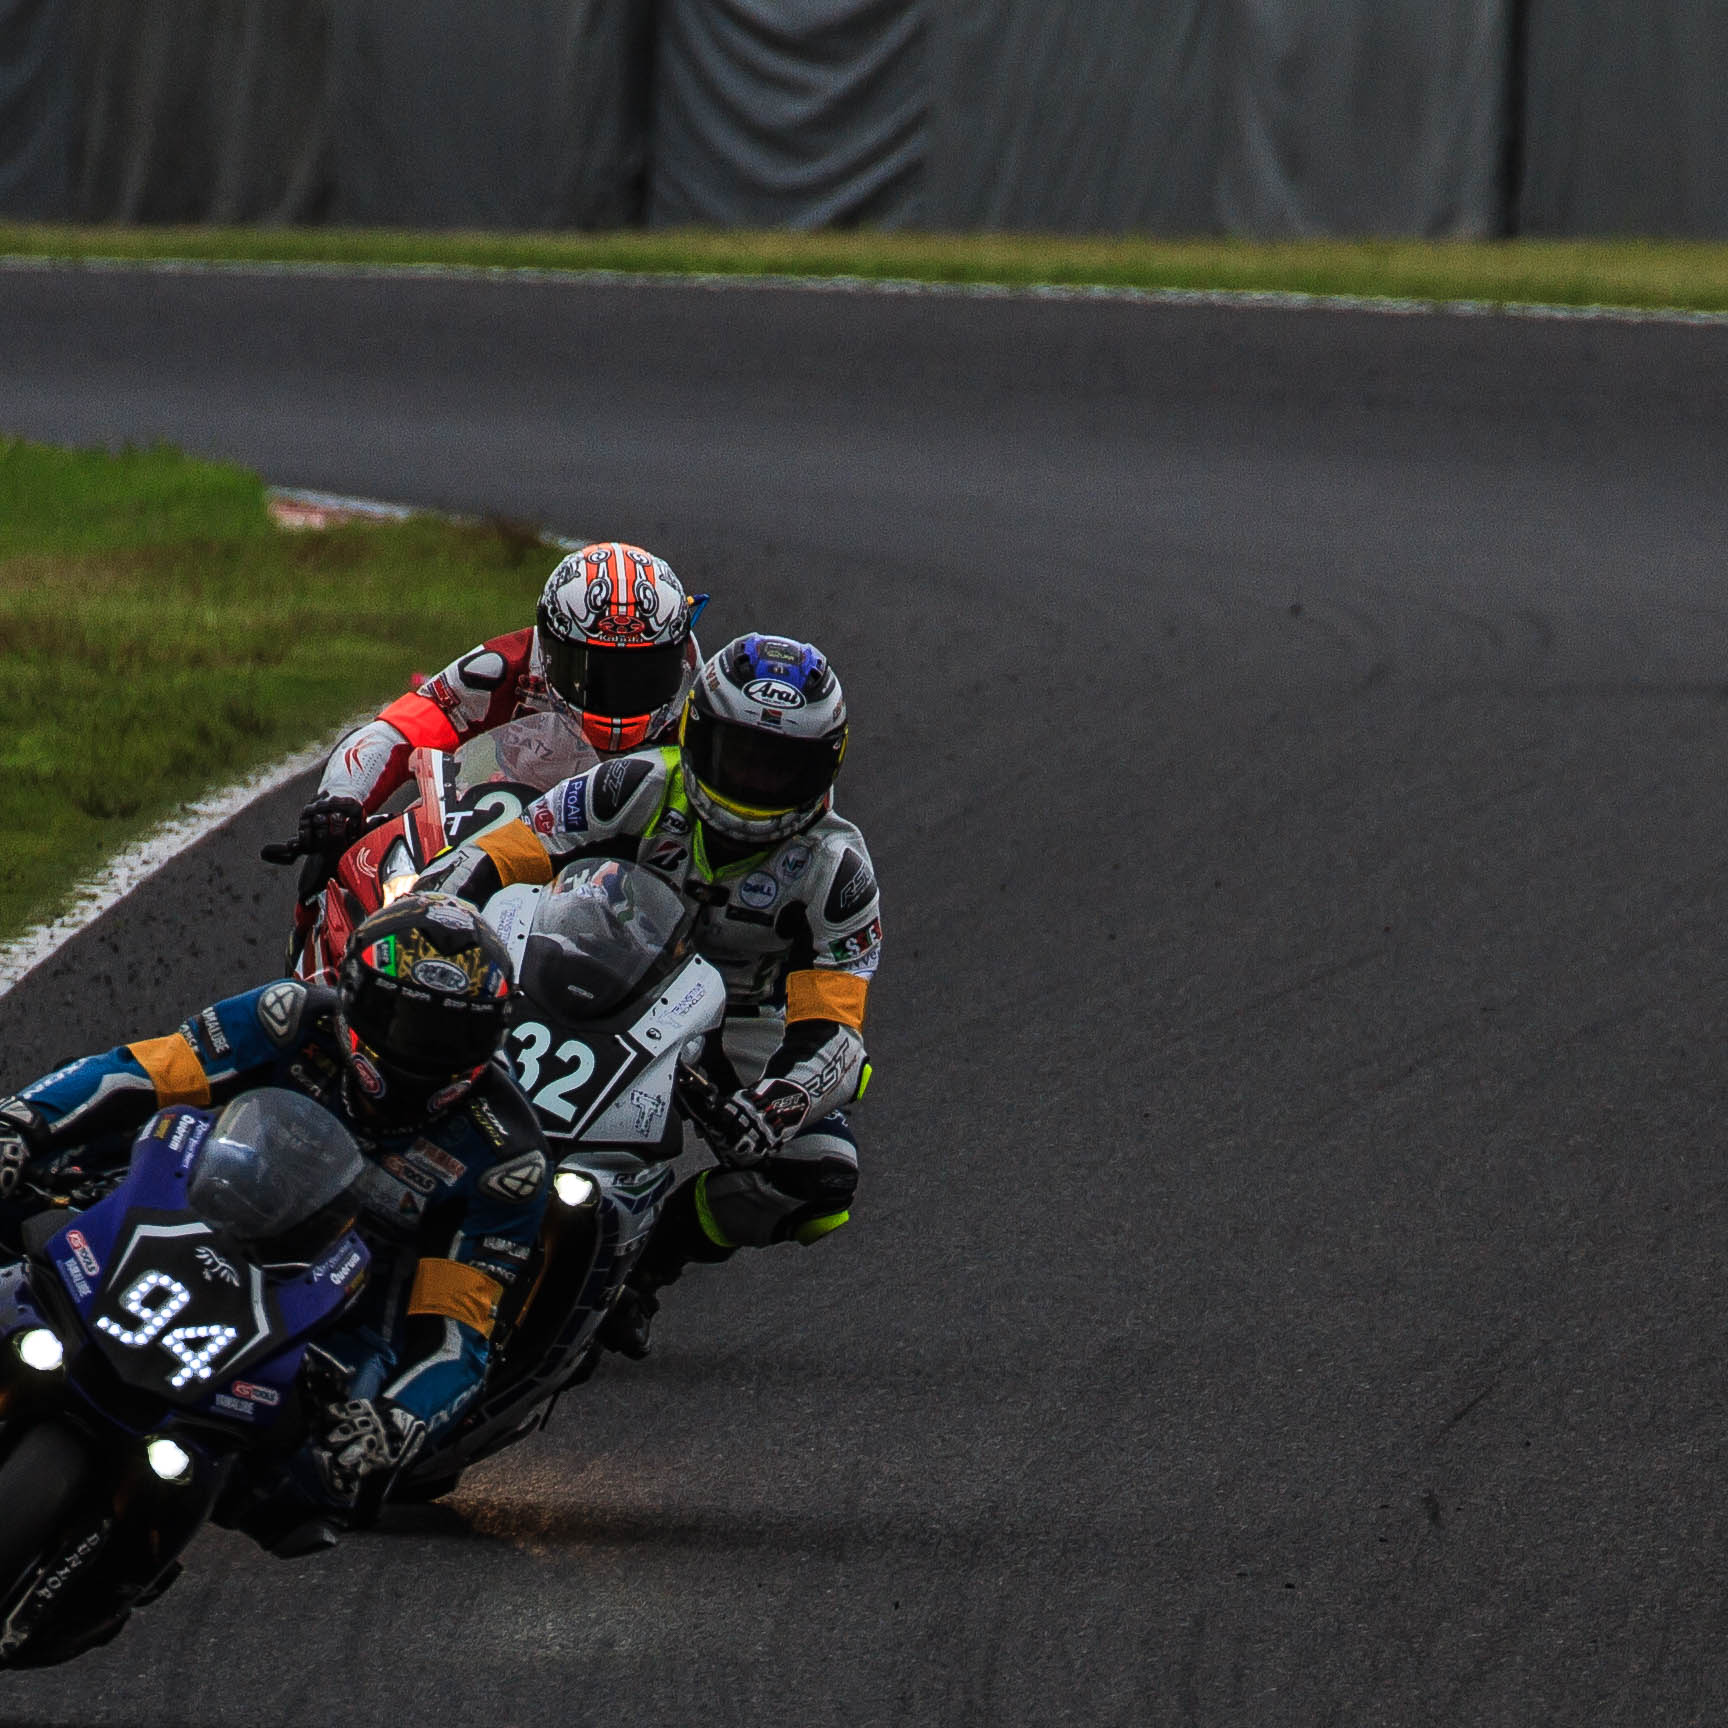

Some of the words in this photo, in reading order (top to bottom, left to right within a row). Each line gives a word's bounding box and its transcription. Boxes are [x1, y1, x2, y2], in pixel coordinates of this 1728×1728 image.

[750, 682, 800, 702] Arai
[571, 780, 585, 826] ProAir
[743, 882, 773, 897] DELL
[512, 1021, 595, 1123] 32
[803, 1037, 850, 1098] RST
[168, 1114, 195, 1152] Quorum
[329, 1252, 362, 1286] Quorum
[95, 1270, 238, 1388] 94
